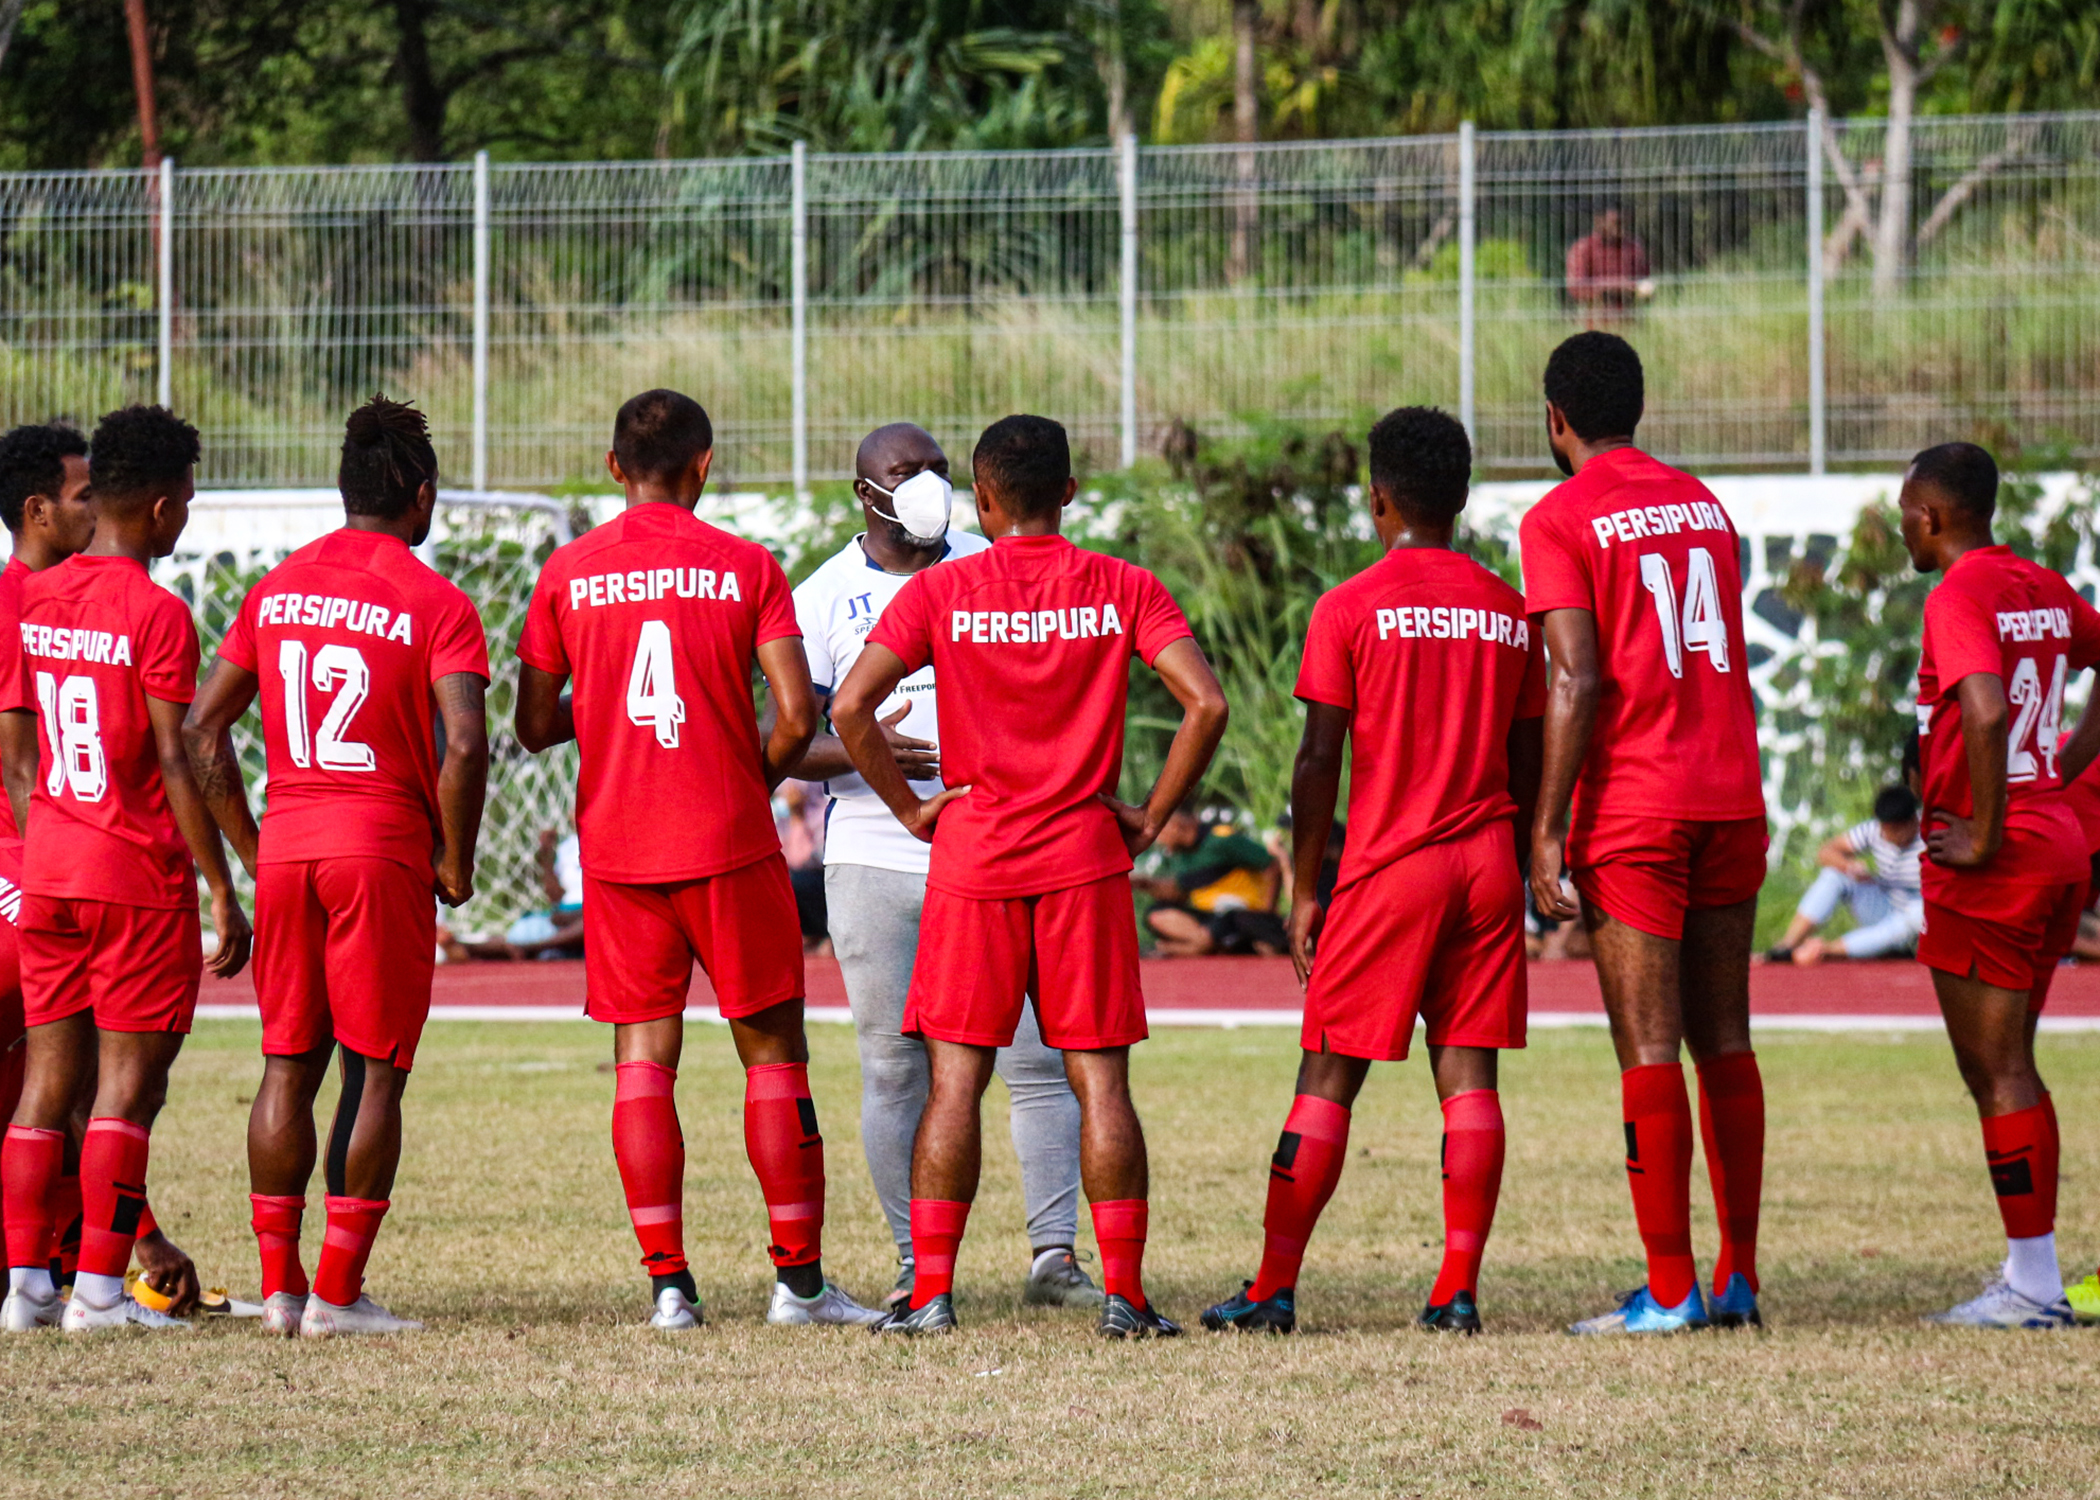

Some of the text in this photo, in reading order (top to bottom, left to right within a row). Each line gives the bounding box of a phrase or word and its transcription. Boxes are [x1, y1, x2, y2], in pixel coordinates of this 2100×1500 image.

[1591, 501, 1730, 549] PERSIPURA
[569, 567, 741, 611] PERSIPURA
[848, 592, 872, 620] JT
[1639, 547, 1731, 679] 14
[258, 593, 412, 646] PERSIPURA
[951, 603, 1123, 644] PERSIPURA
[1376, 606, 1529, 652] PERSIPURA
[1996, 605, 2073, 643] PERIPUR
[20, 622, 132, 667] PERSIPURA
[279, 639, 377, 772] 12
[626, 619, 686, 749] 4
[36, 671, 108, 803] 18
[2007, 653, 2067, 783] 24
